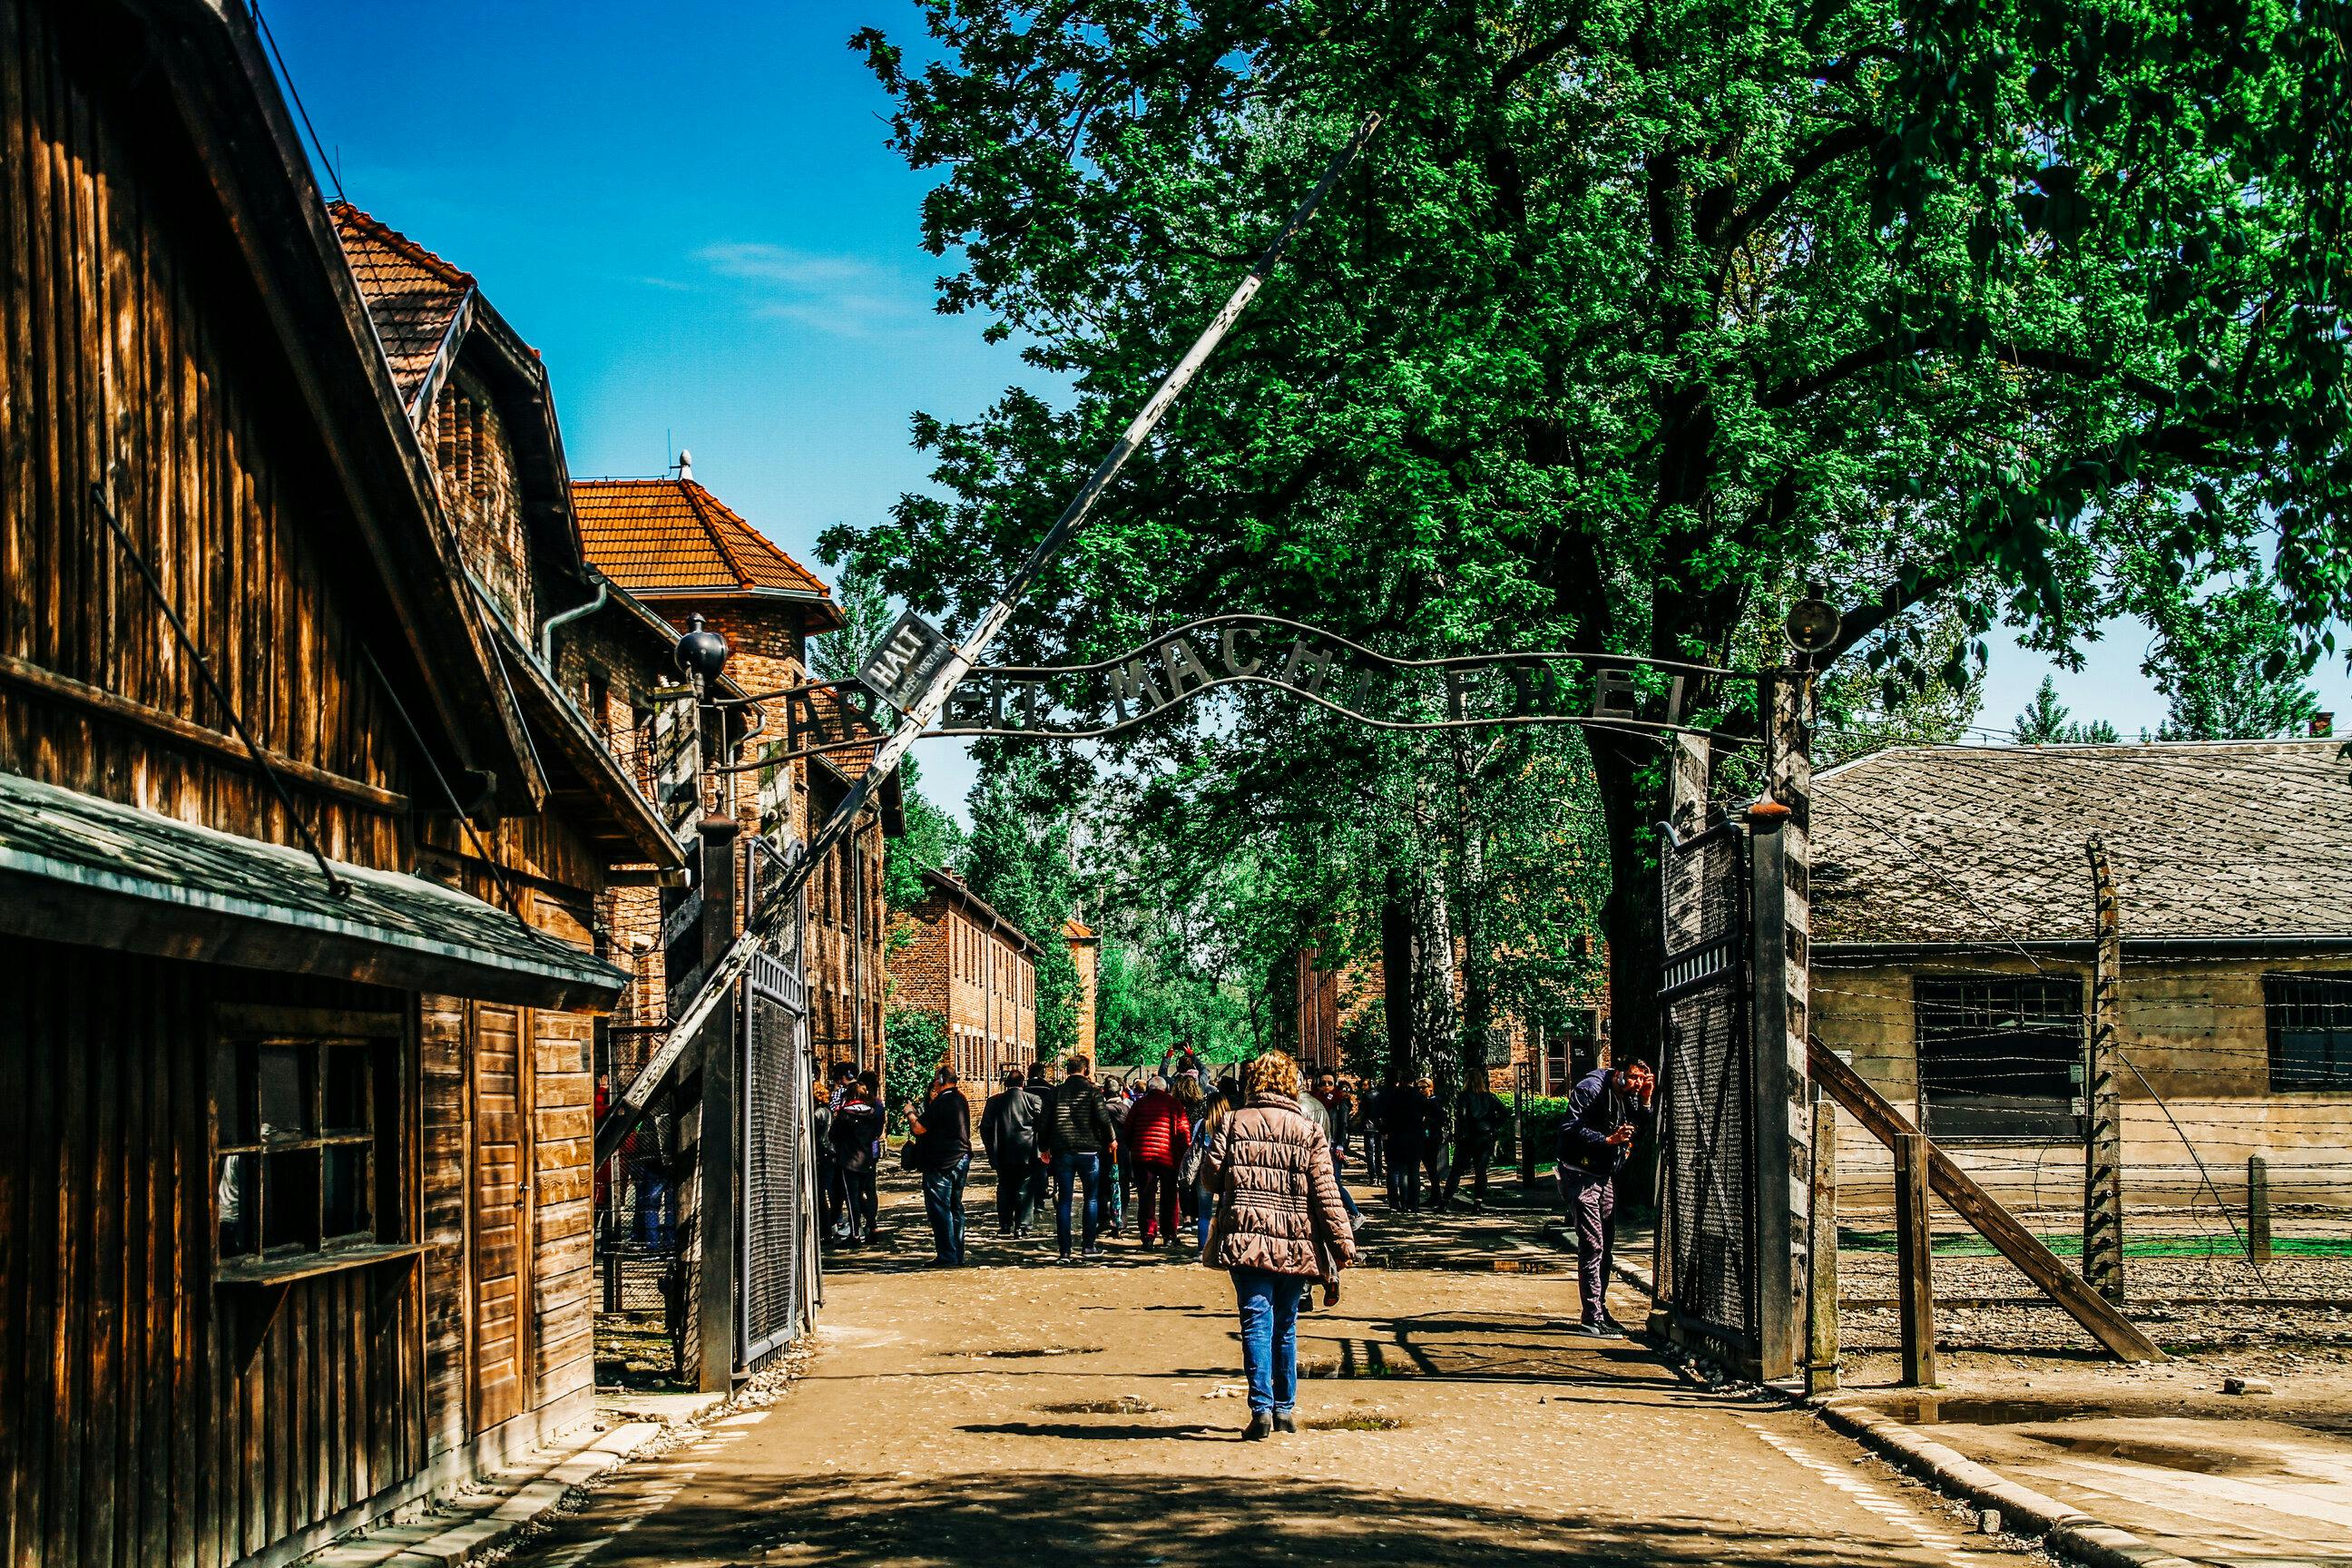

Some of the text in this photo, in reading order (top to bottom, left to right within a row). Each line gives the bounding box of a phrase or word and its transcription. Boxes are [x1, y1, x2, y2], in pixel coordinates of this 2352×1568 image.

[868, 624, 924, 689] HALT
[787, 671, 1047, 752] AREIT
[1449, 661, 1685, 725] FREI
